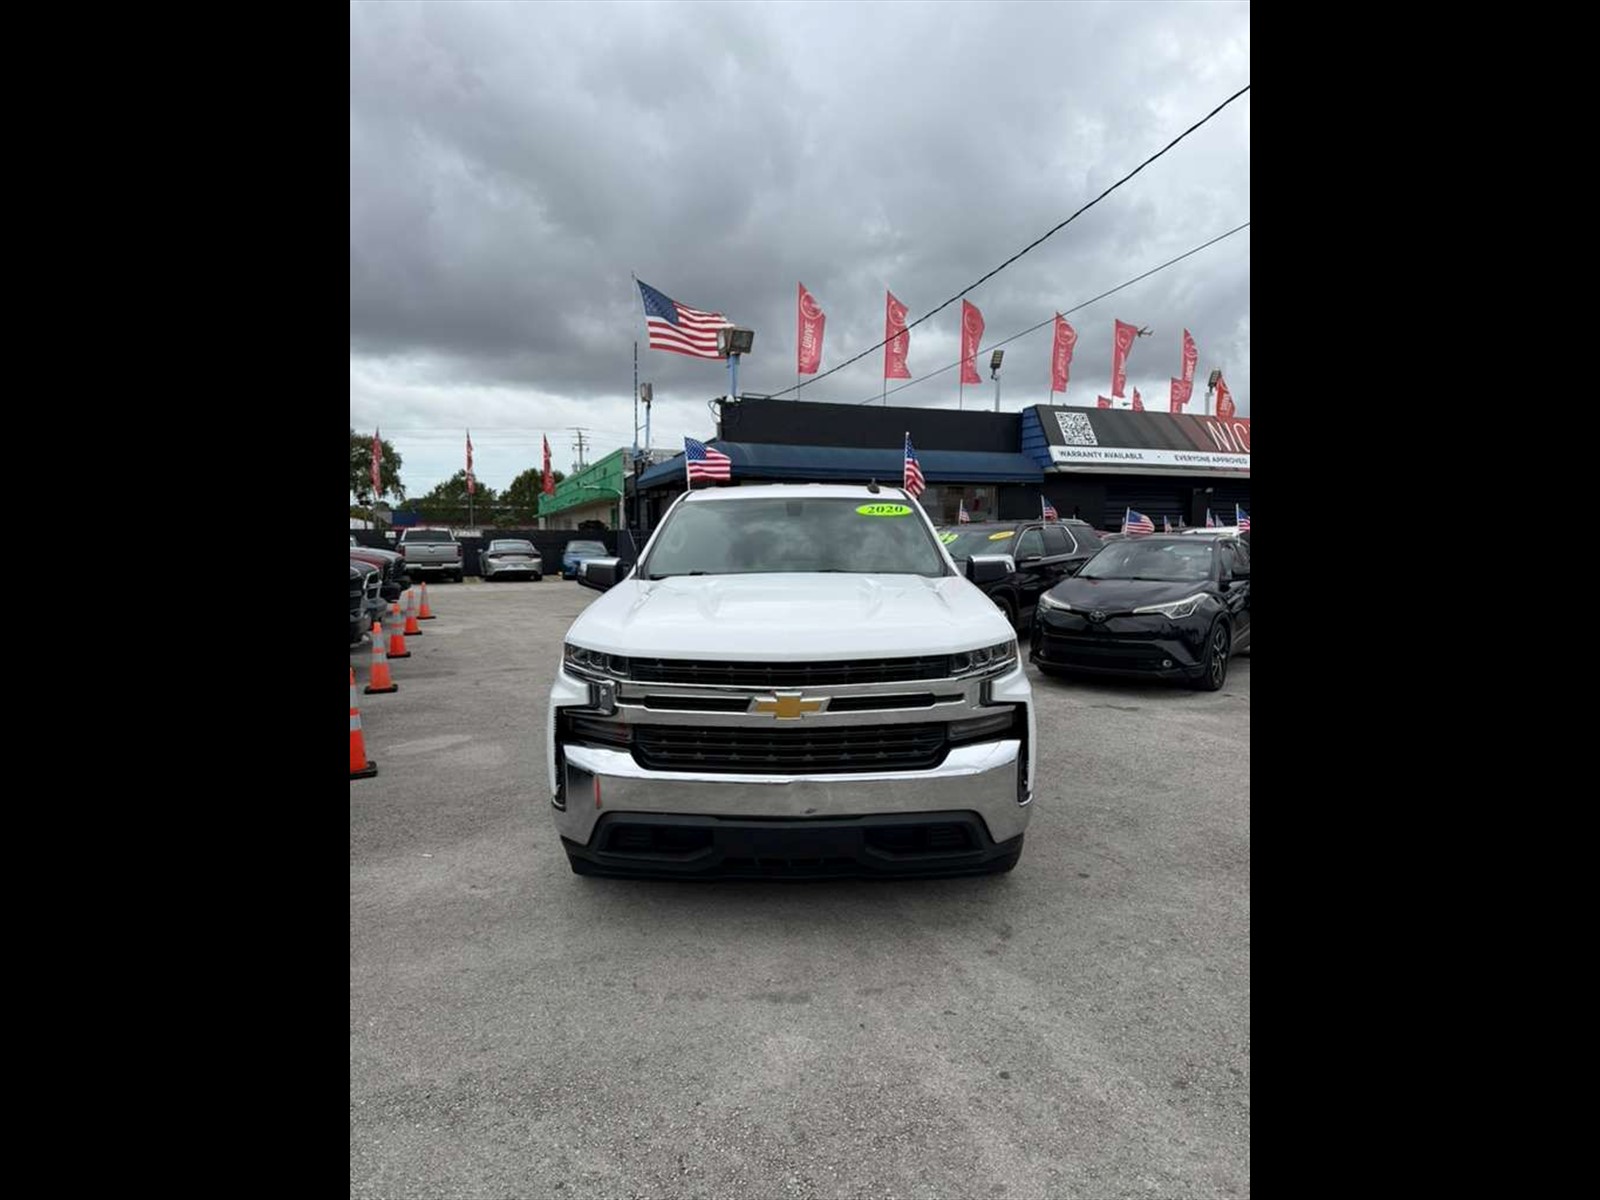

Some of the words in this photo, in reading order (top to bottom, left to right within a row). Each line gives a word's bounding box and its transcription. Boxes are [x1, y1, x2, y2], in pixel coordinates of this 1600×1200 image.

[802, 320, 815, 348] DRIVE
[1206, 421, 1250, 452] NIC
[1058, 450, 1102, 458] WARRANTY
[867, 505, 904, 514] 2020
